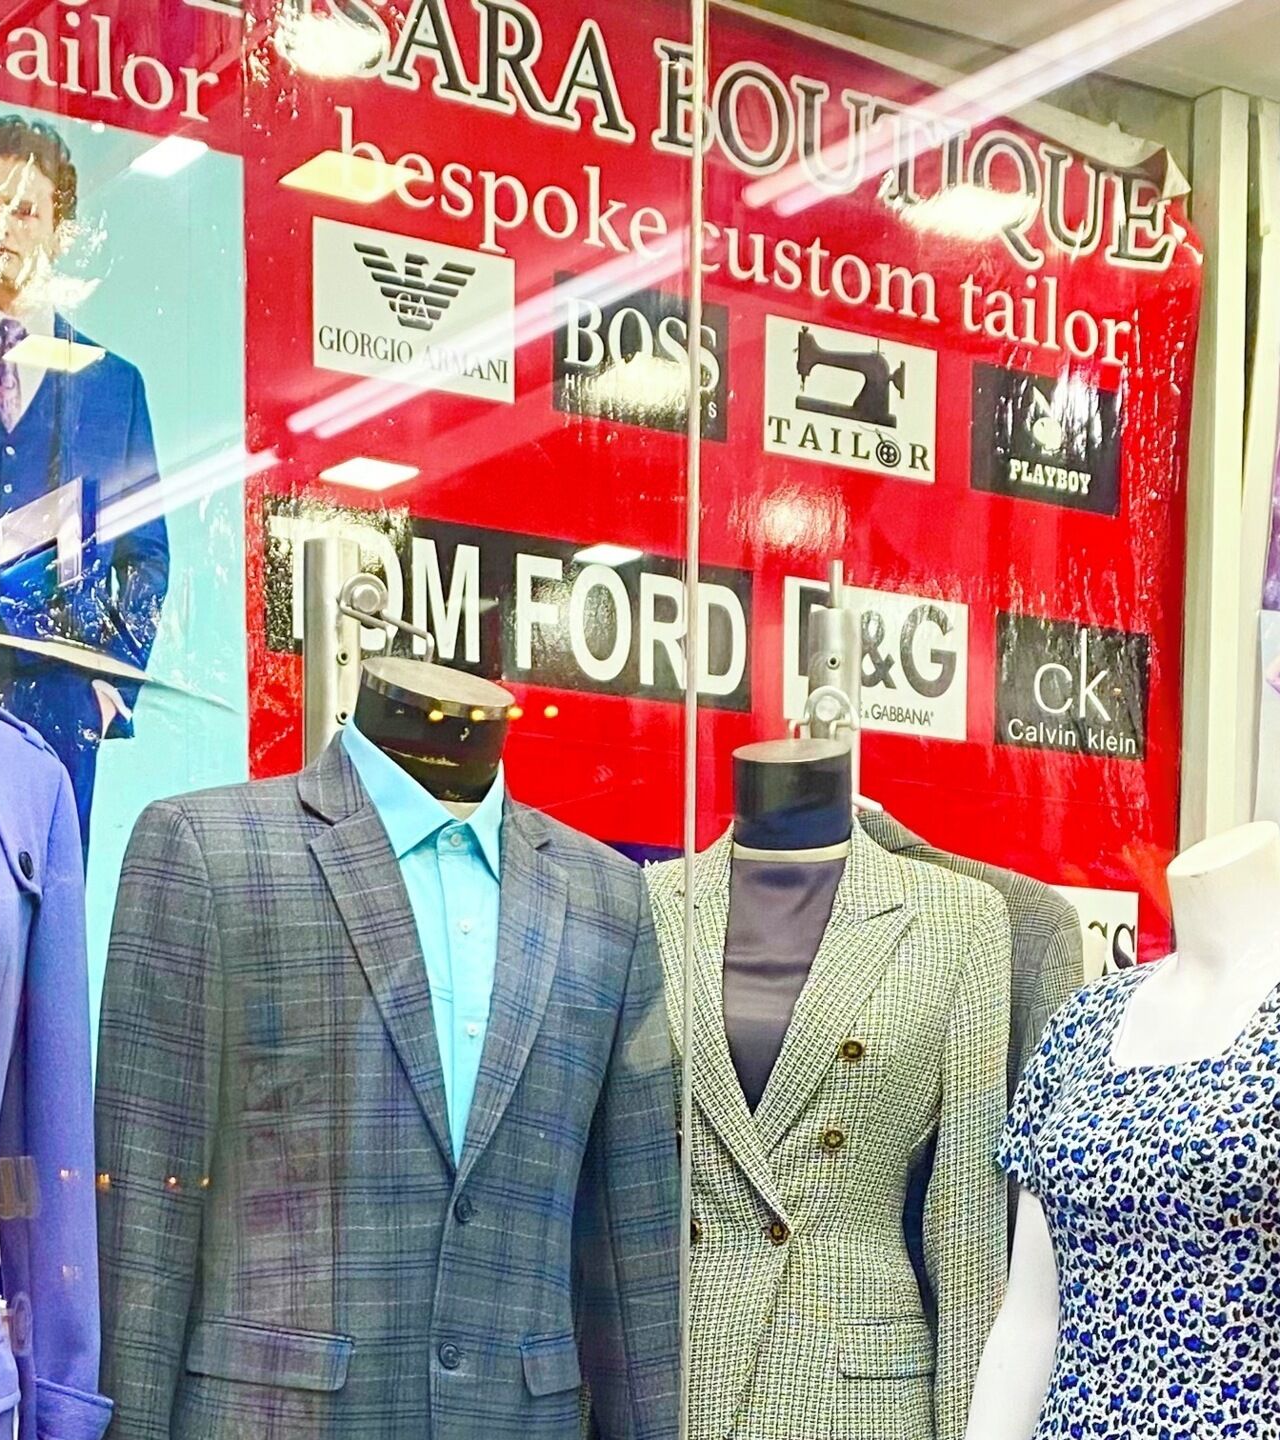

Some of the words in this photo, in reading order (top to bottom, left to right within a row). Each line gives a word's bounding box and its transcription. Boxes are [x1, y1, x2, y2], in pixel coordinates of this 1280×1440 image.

[653, 37, 1177, 271] BOUTIQUE
[334, 105, 669, 261] bespoke
[690, 219, 940, 325] custom
[959, 272, 1132, 367] tailor
[318, 324, 413, 365] GIORGIO
[422, 344, 509, 385] ARMANI
[563, 296, 721, 392] BOSS
[768, 415, 931, 473] TAILOR
[1008, 457, 1092, 496] PLAYBOY
[515, 552, 748, 696] FORD
[870, 703, 932, 727] GABBANA
[1007, 717, 1076, 747] Calvin
[1087, 727, 1136, 754] klein
